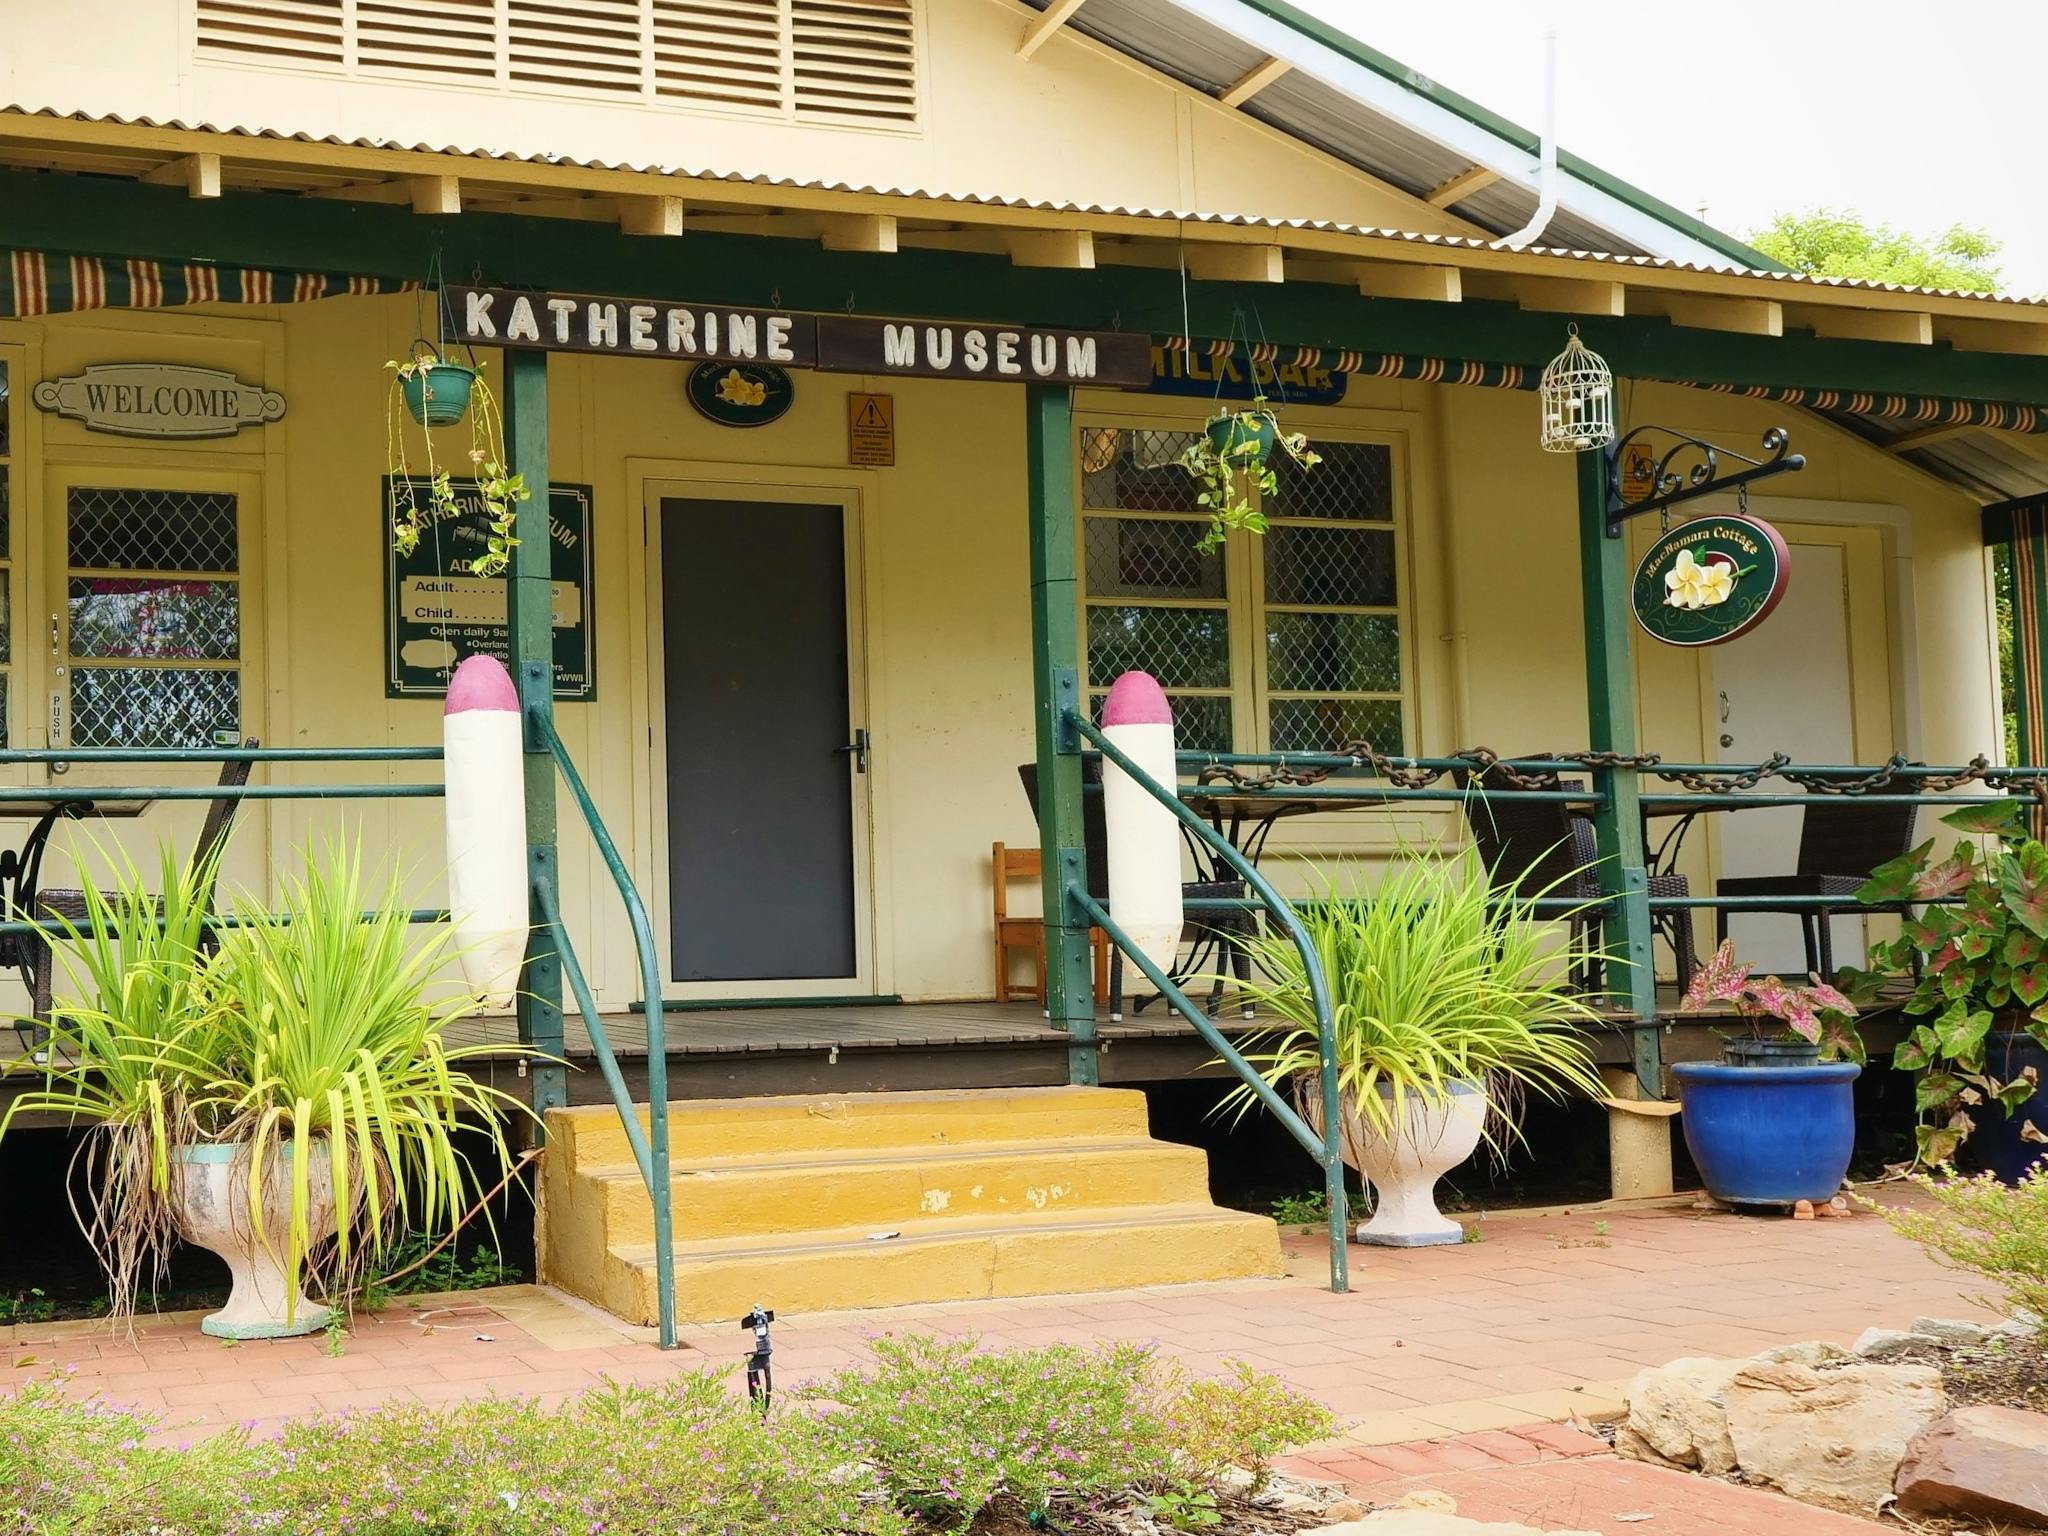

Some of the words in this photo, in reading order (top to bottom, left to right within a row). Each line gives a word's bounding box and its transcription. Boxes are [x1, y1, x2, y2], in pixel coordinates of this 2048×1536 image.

[466, 291, 794, 361] KATHERINE
[883, 324, 1097, 378] MUSEUM
[85, 383, 239, 418] WELCOME
[1645, 530, 1710, 579] MacNamara
[1713, 526, 1760, 556] Cottage
[430, 626, 461, 637] Open
[463, 627, 490, 639] daily
